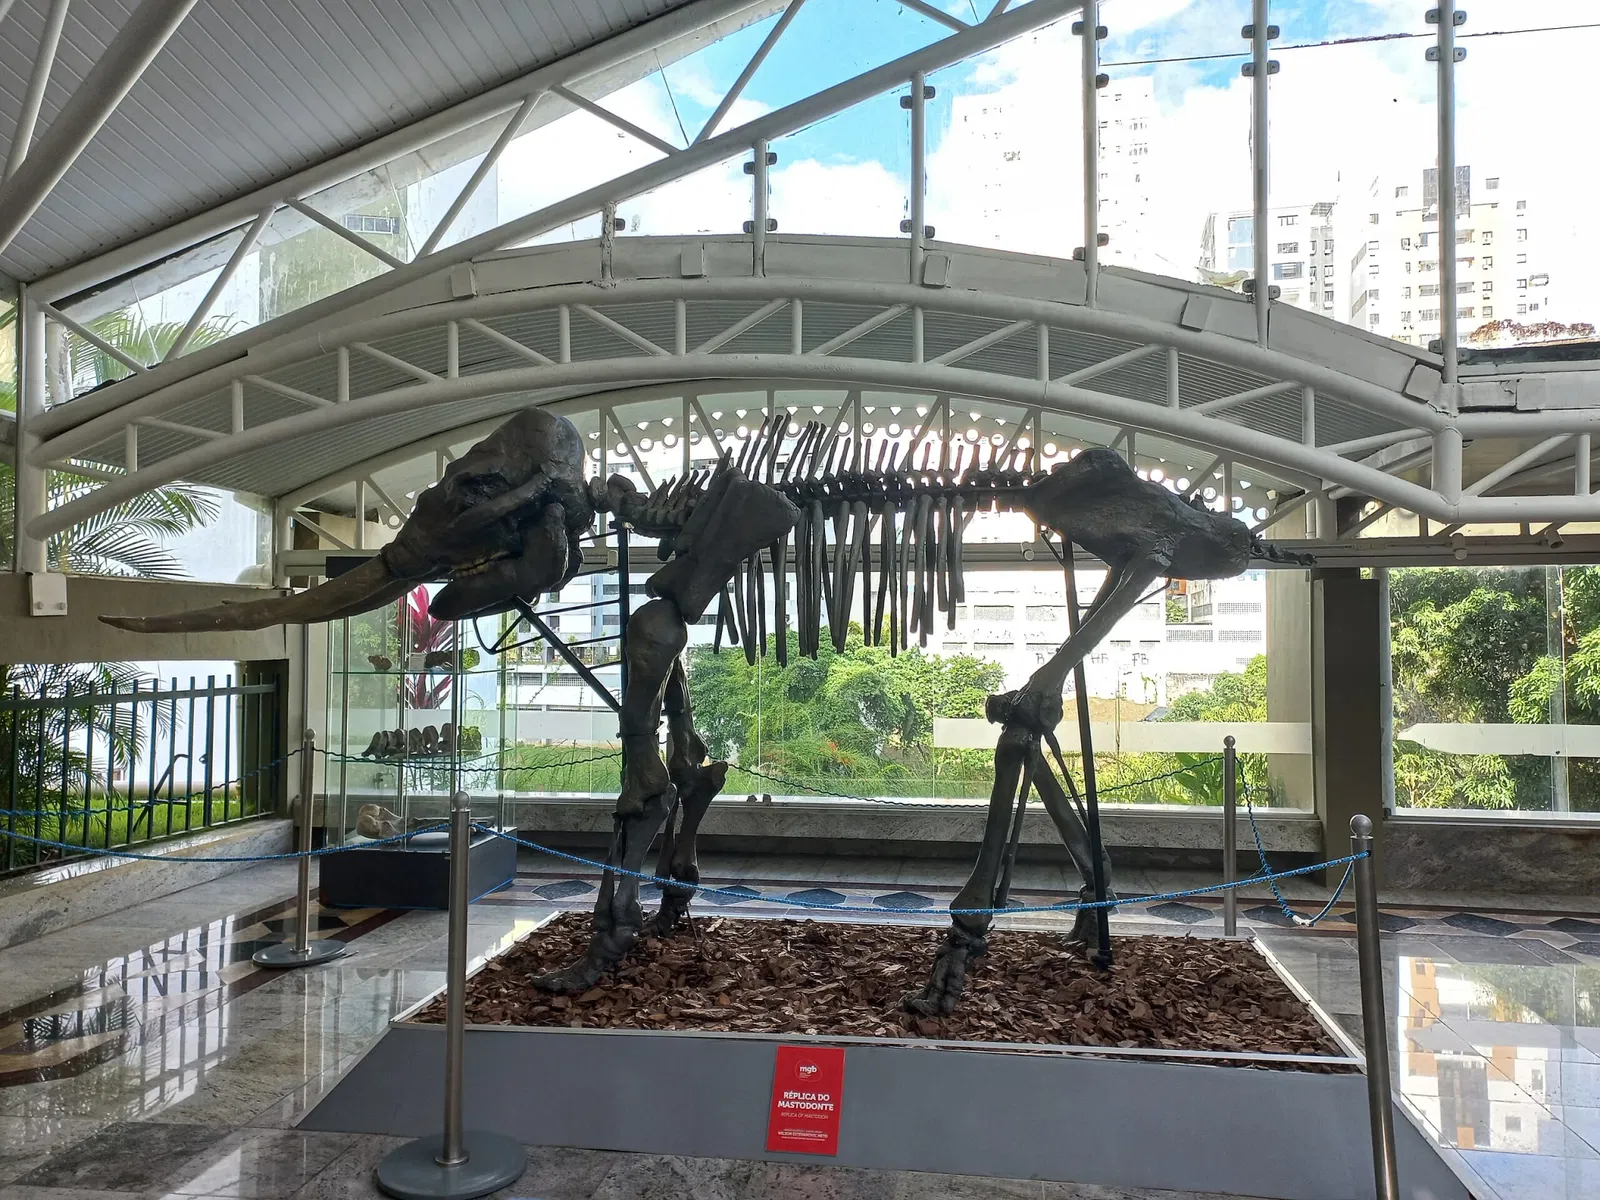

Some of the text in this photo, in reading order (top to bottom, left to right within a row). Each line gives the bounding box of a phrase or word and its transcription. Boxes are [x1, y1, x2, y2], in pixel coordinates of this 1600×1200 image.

[800, 1066, 817, 1074] mgb
[783, 1091, 816, 1100] RÉPLICA
[777, 1101, 834, 1111] MASTODONTE
